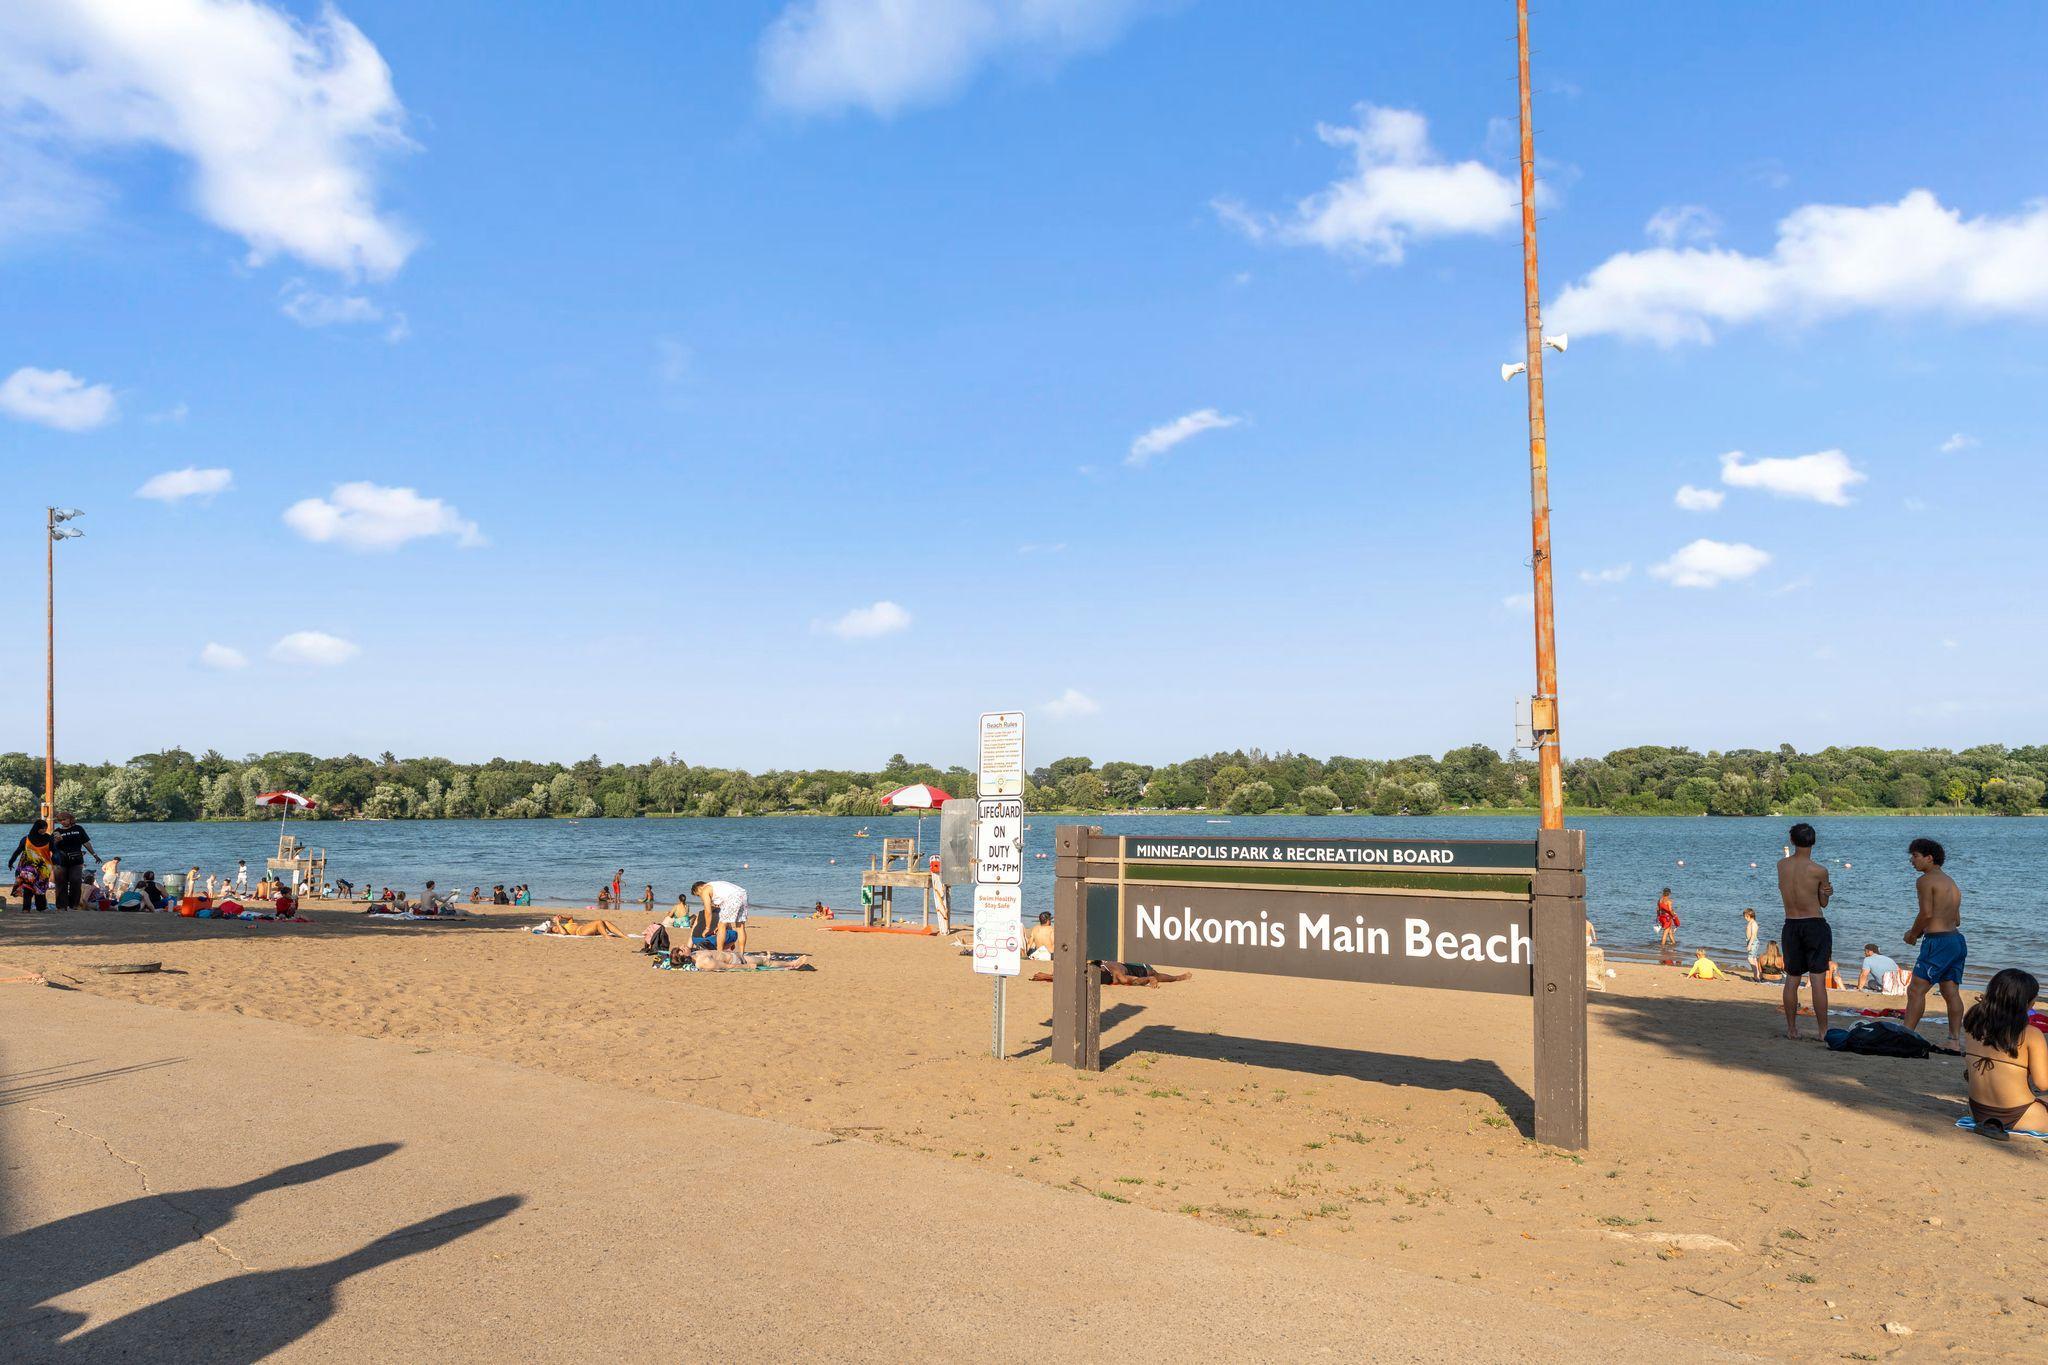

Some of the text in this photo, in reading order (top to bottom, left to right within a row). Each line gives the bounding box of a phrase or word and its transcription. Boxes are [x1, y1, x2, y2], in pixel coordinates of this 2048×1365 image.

[980, 806, 1020, 818] LIFEGUARD
[994, 826, 1005, 838] ON
[989, 846, 1010, 858] DUTY
[1136, 844, 1454, 864] MINNEAPOLIS PARK & RECREATION BOARD
[1136, 904, 1533, 965] Nokomis Main Beach
